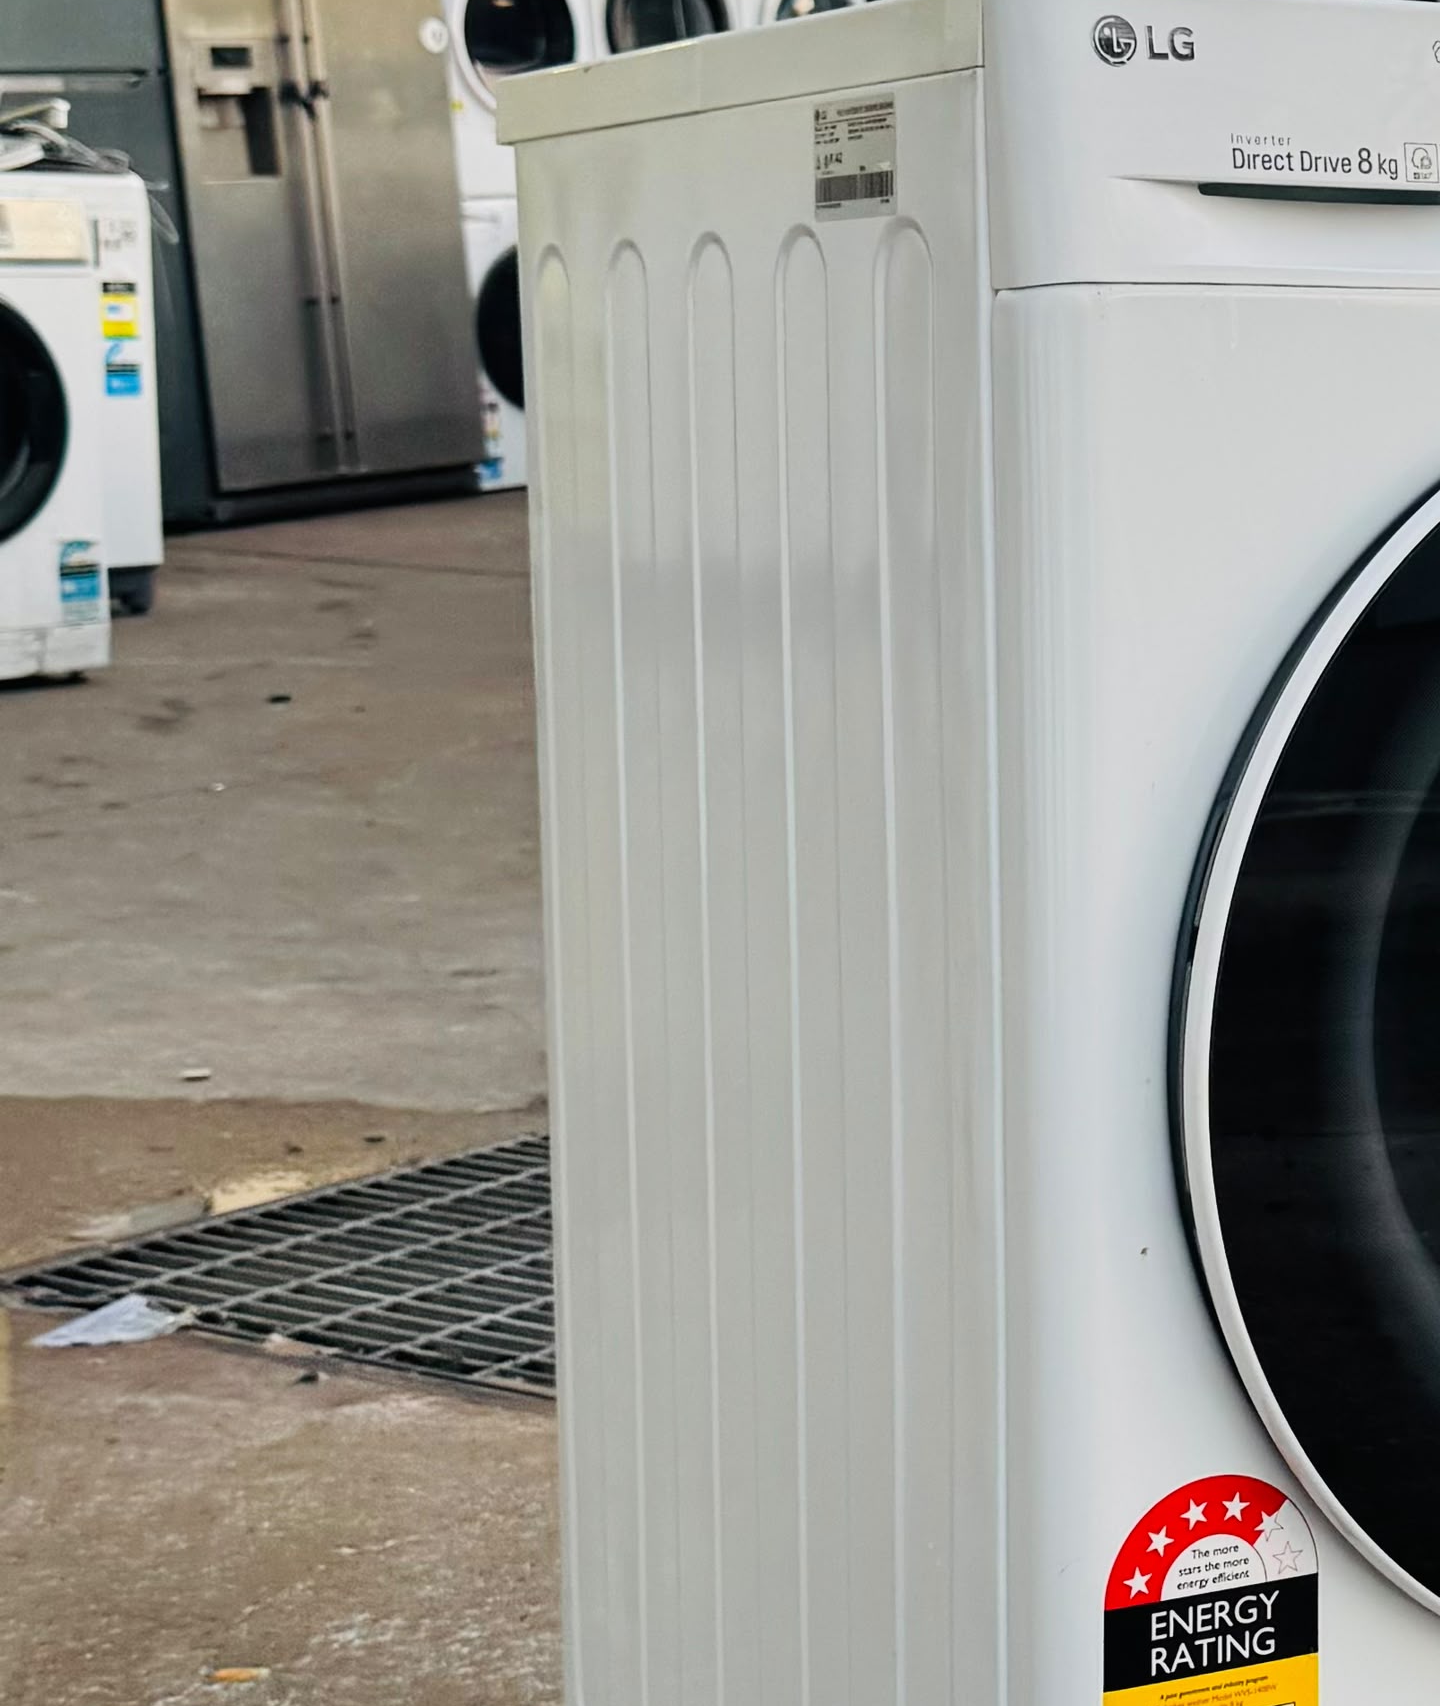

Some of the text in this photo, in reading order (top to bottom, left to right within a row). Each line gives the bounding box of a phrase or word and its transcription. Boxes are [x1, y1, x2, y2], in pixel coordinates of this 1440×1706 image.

[1145, 25, 1195, 61] LG
[1230, 132, 1292, 146] Inverter
[1232, 147, 1398, 180] Direct Drive 8 kg
[1191, 1545, 1239, 1560] The more
[1177, 1570, 1250, 1590] energy efficient
[1179, 1557, 1249, 1577] stars the more
[1150, 1590, 1280, 1642] ENERGY
[1151, 1627, 1276, 1677] RATING
